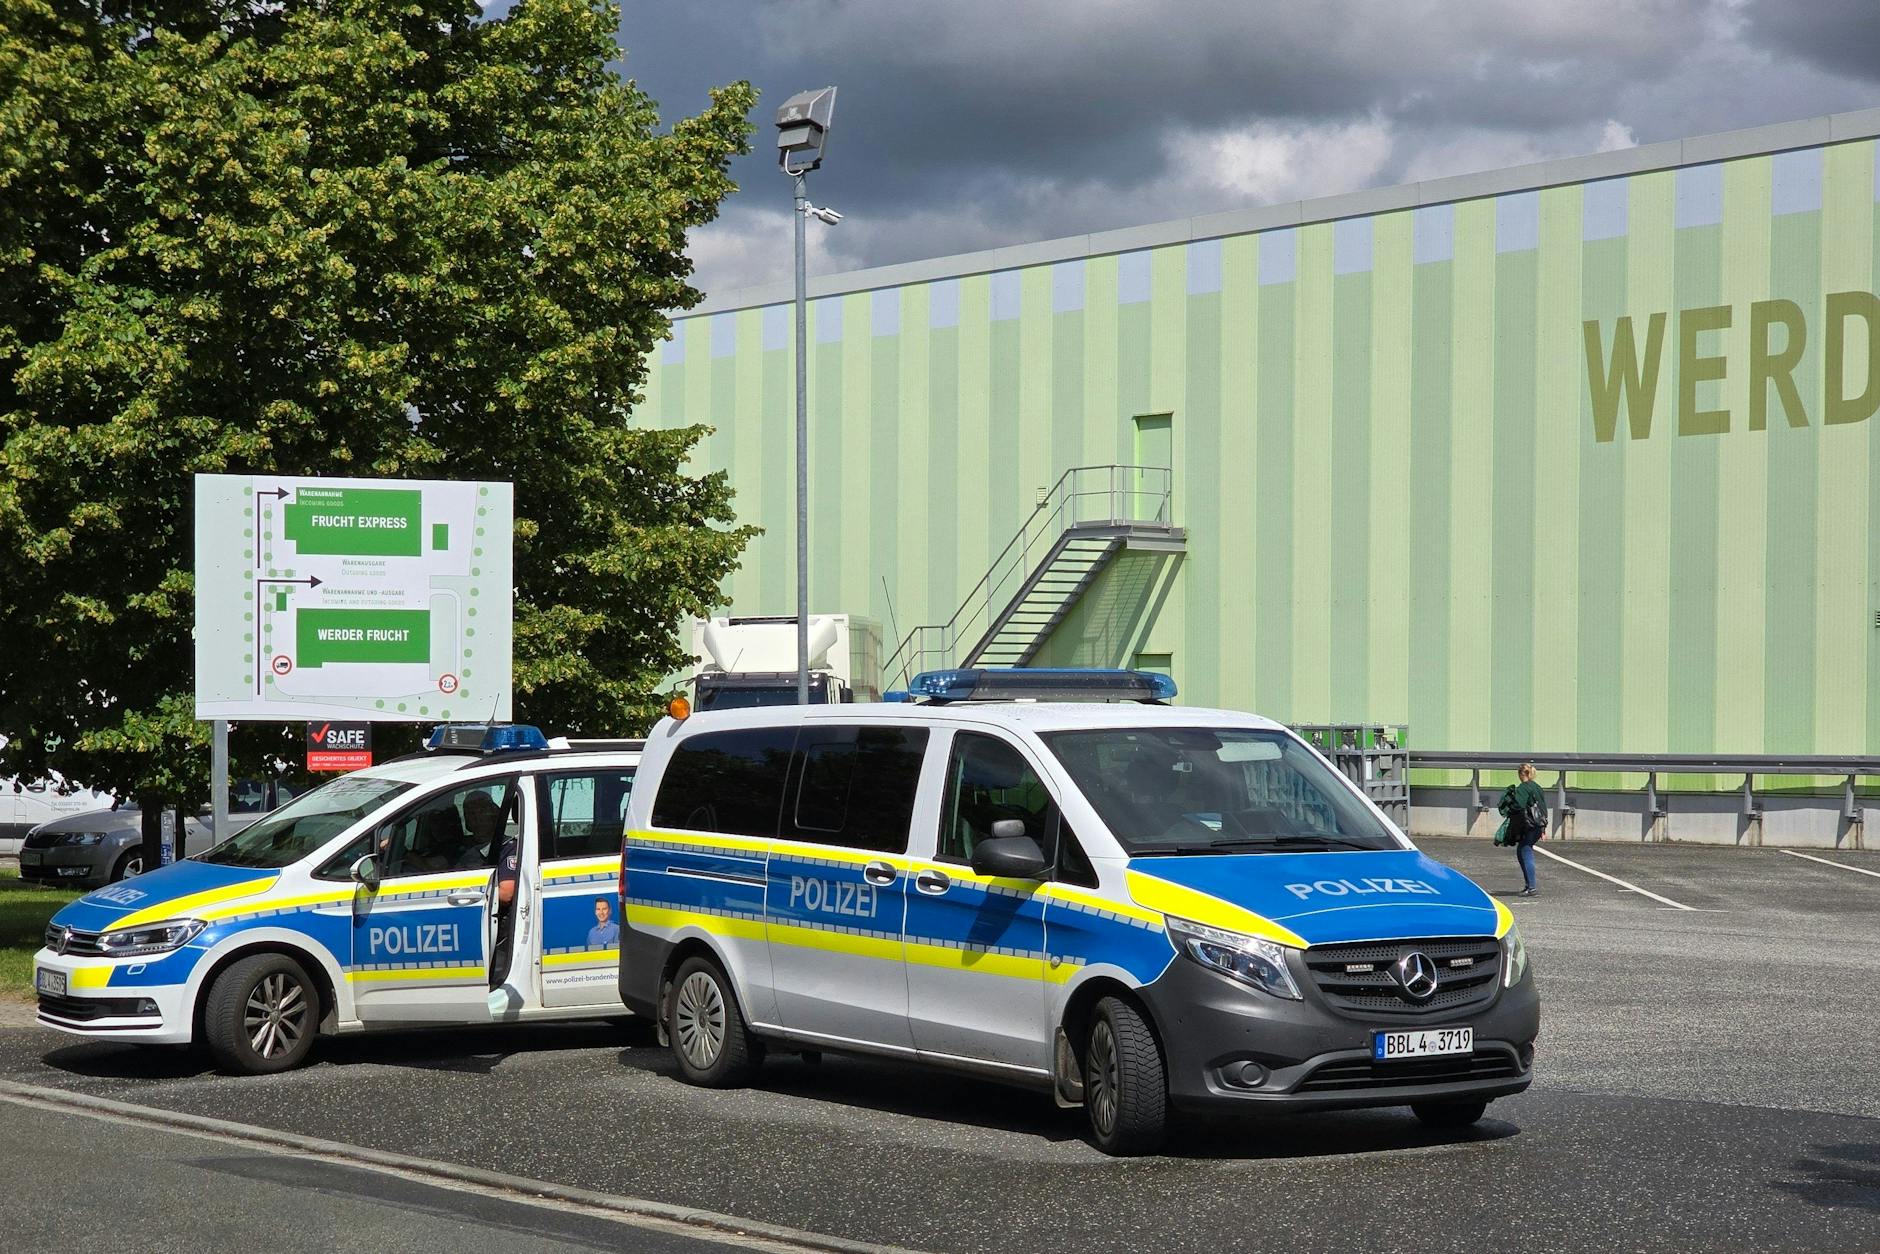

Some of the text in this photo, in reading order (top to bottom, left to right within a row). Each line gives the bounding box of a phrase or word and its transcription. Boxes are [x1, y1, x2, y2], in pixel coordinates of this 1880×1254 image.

[1582, 291, 1880, 443] WERD
[311, 515, 407, 529] FRUCHT EXPRESS
[317, 628, 410, 642] WERDER FRUCHT
[326, 730, 365, 744] SAFE
[789, 875, 878, 918] POLIZEI
[1284, 878, 1441, 900] POLIZEI
[369, 923, 460, 955] POLIZEI
[1387, 1034, 1415, 1055] BBL
[1419, 1033, 1427, 1052] 4
[1438, 1029, 1470, 1051] 3719
